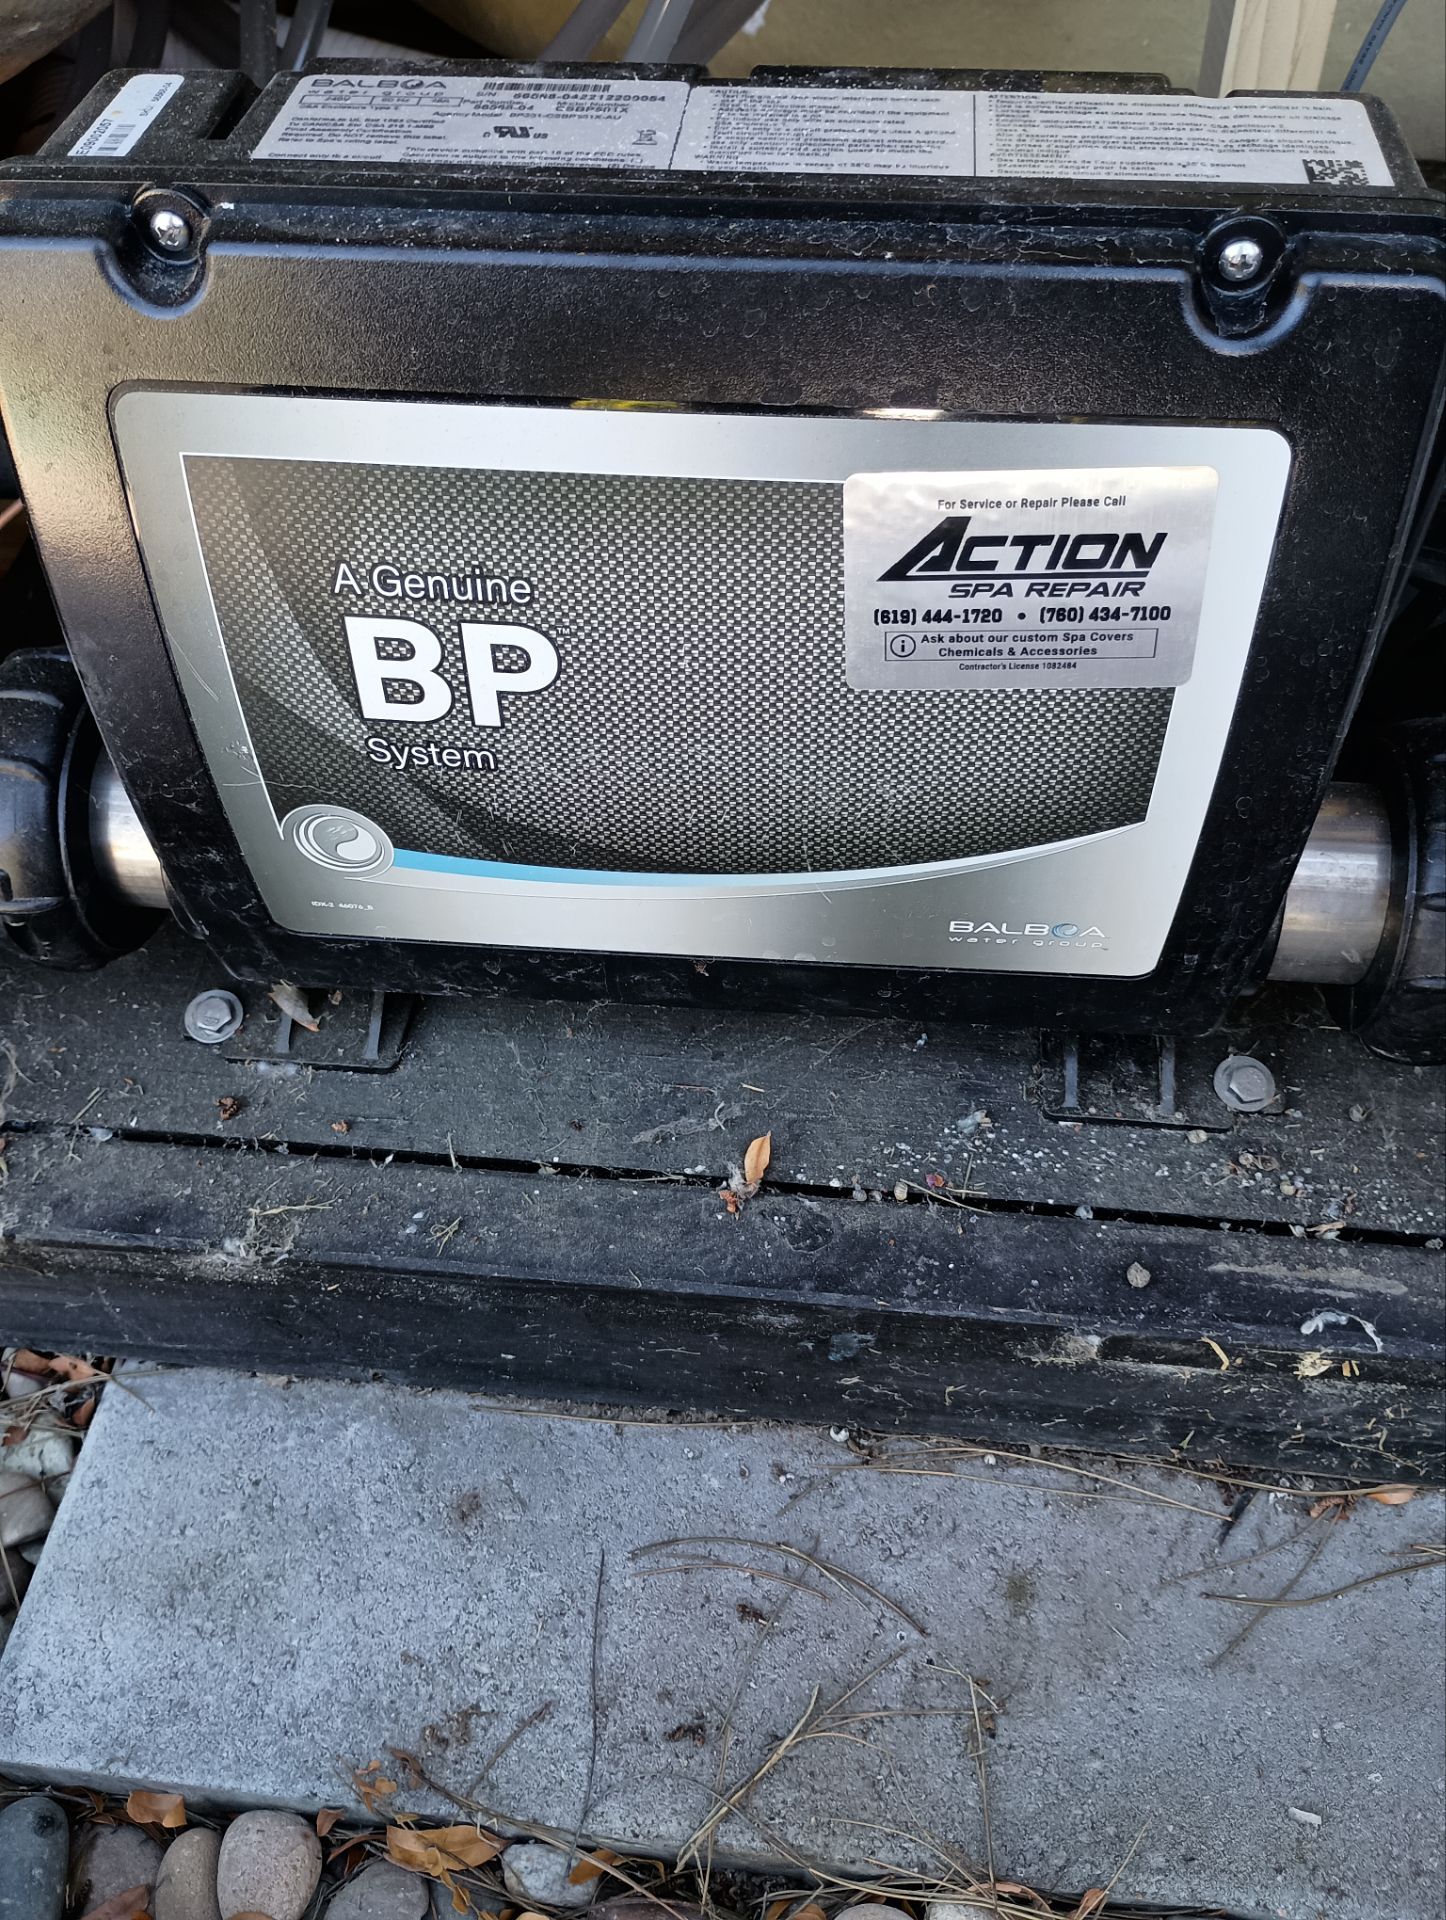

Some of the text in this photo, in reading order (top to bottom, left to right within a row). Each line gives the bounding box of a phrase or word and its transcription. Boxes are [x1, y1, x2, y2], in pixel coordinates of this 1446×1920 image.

[311, 79, 447, 90] BALBOA
[938, 496, 1126, 510] For Service or Repair Please Call
[876, 516, 1168, 582] ACTION
[334, 563, 532, 604] A Genuine
[948, 581, 1147, 599] SPA REPAIR
[874, 605, 1171, 626] (619) 444-1720 (760) 434-7100
[921, 631, 1134, 644] Ask about our custom Spa Covers
[938, 646, 1098, 658] Chemicals & Accessories
[344, 616, 559, 728] BP
[959, 662, 1007, 672] Contractor's
[1008, 662, 1040, 671] License
[366, 737, 496, 770] System
[949, 920, 1106, 938] BALBOA
[948, 936, 1103, 948] water group
